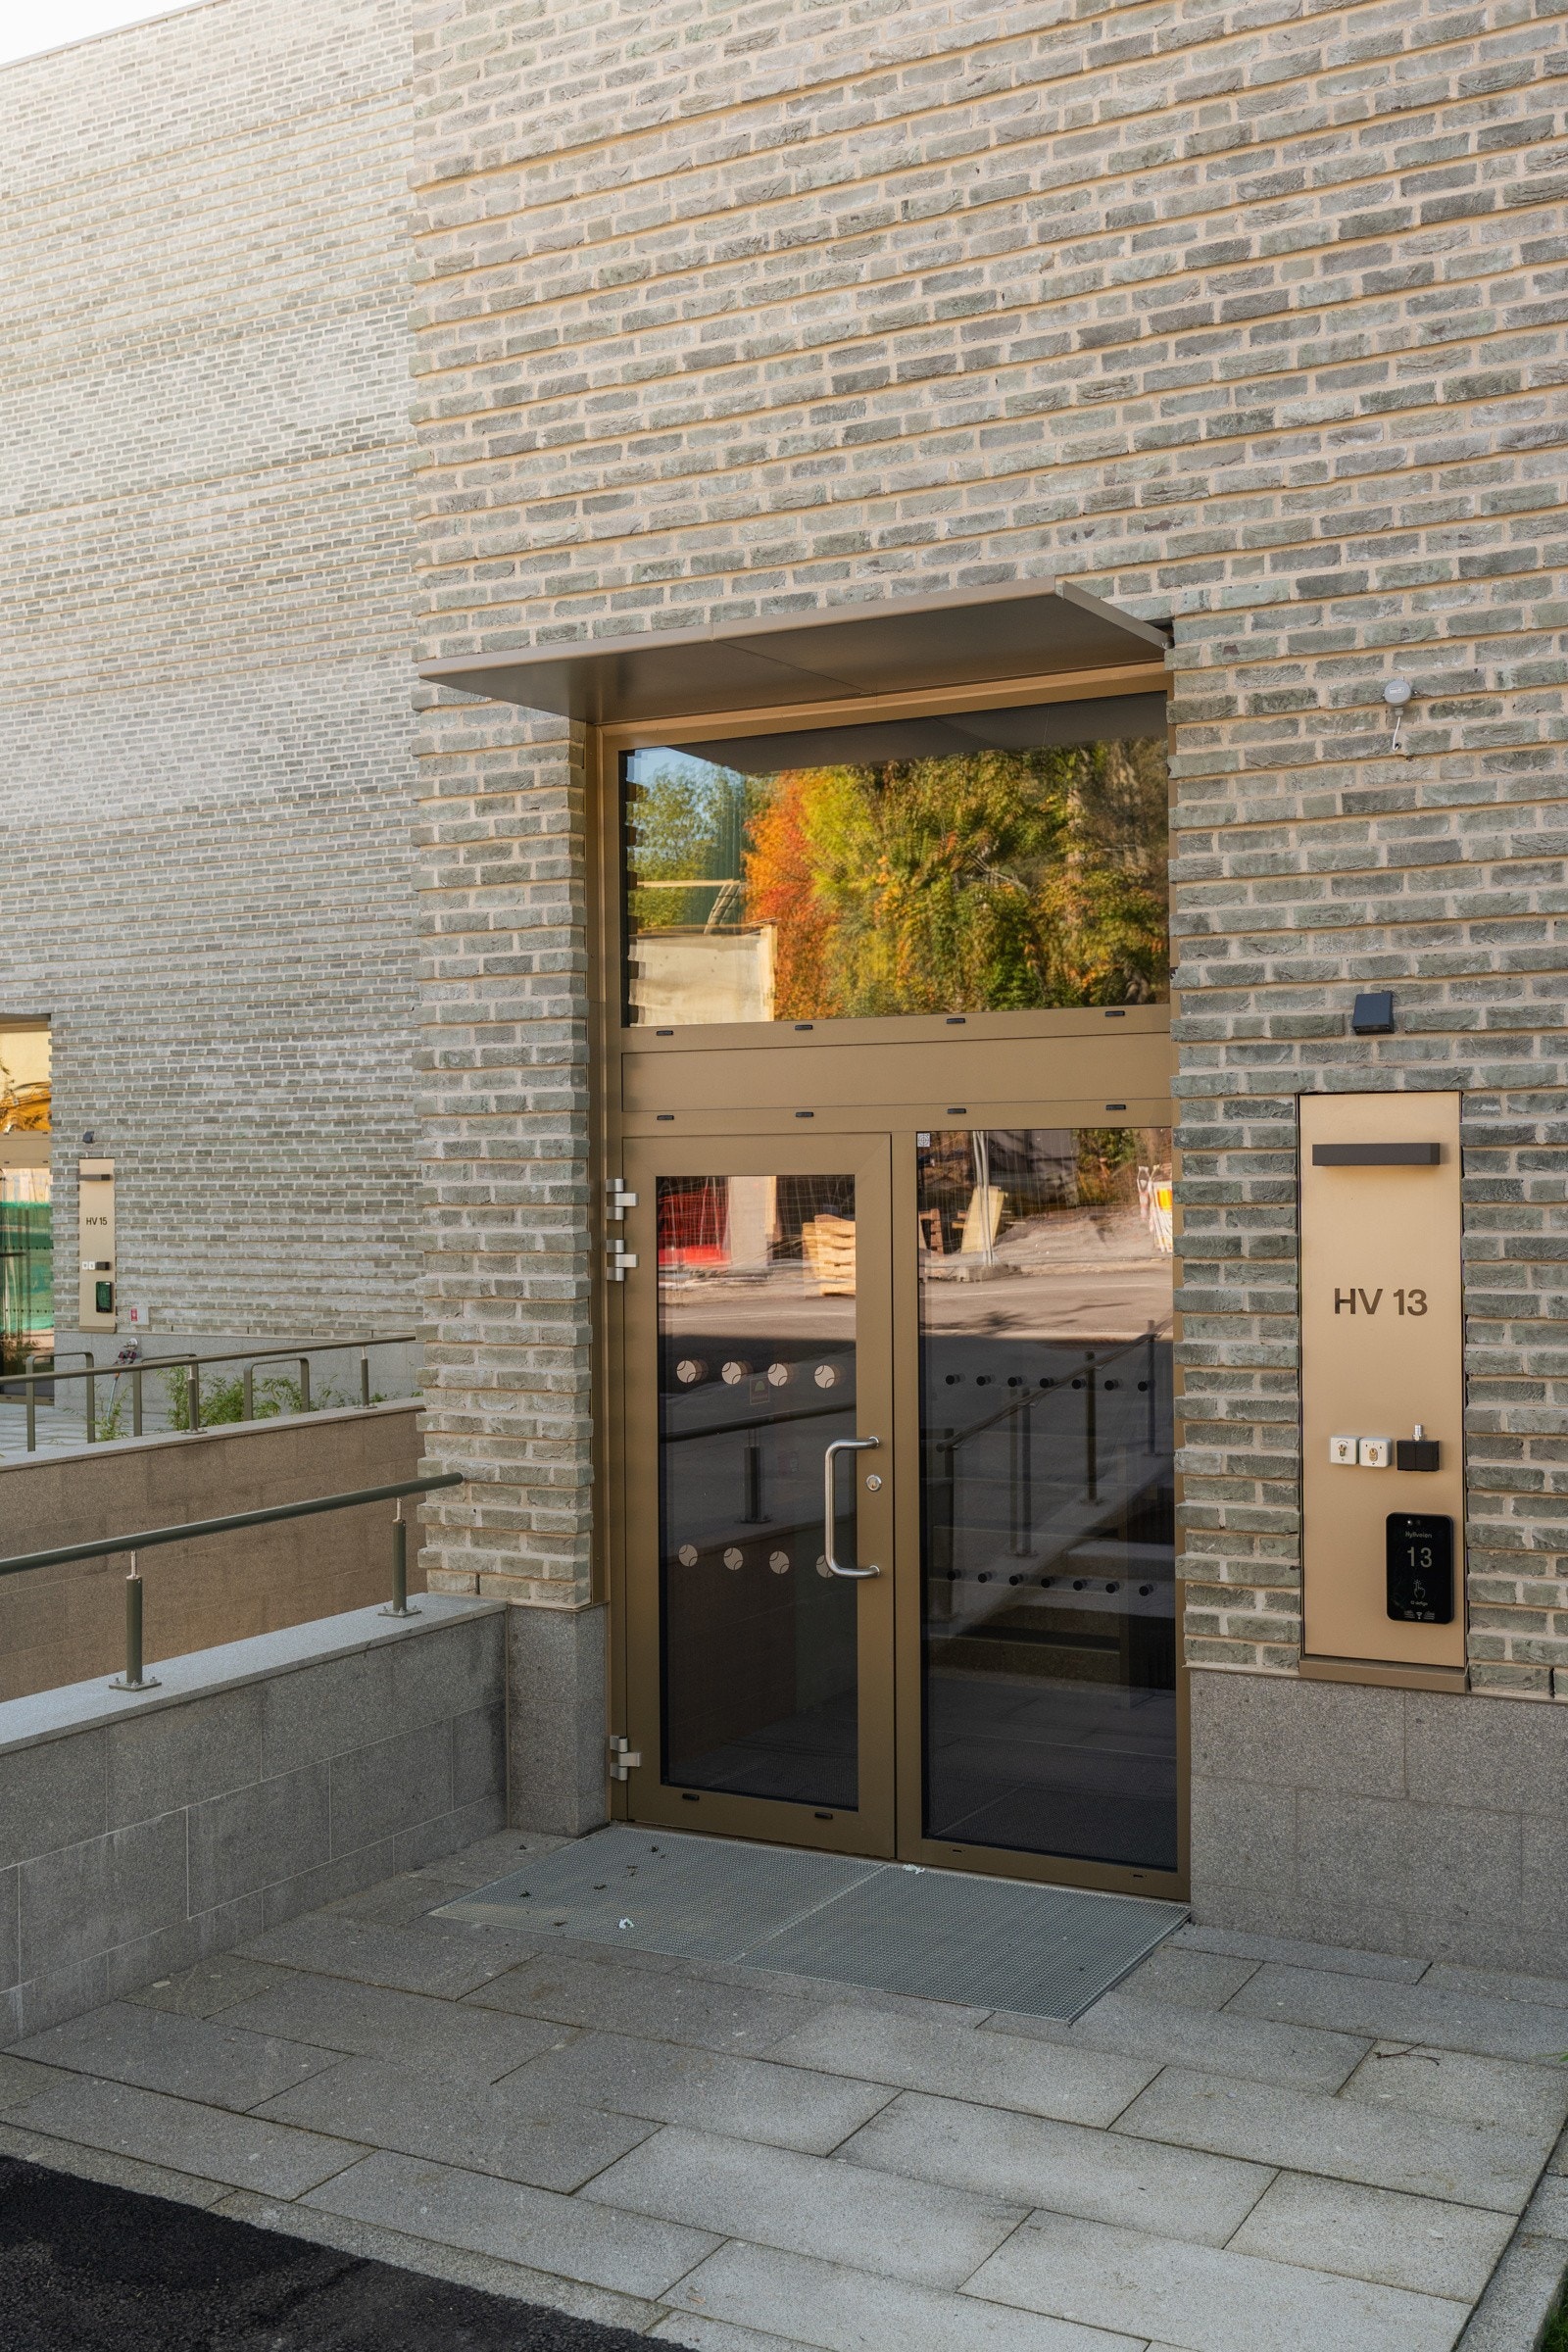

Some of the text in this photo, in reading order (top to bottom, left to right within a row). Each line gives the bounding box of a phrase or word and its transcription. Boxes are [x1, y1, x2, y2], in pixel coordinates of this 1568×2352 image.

[1335, 1288, 1428, 1316] HV 13
[1407, 1546, 1432, 1568] 13
